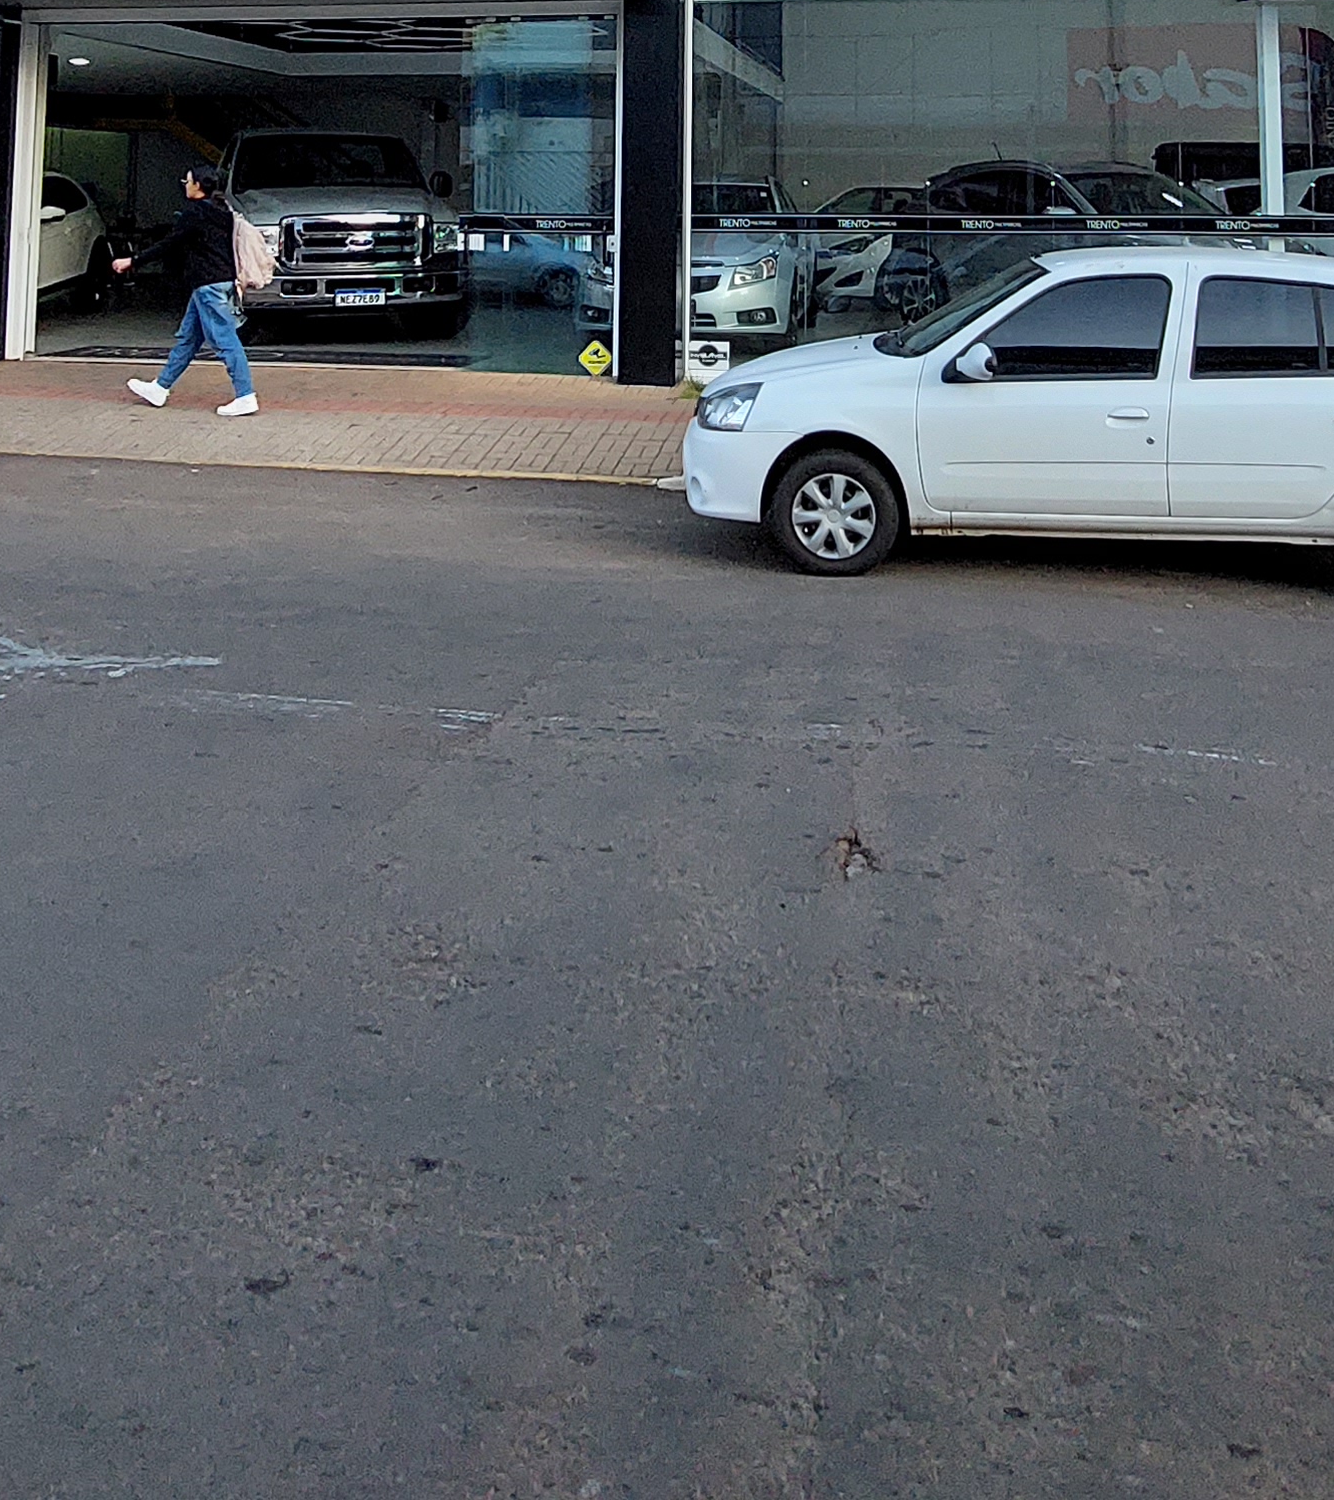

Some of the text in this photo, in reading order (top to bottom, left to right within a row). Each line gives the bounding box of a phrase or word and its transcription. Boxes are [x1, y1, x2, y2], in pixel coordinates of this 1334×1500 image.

[536, 220, 566, 229] TRENTO
[719, 219, 751, 228] TRENTO
[837, 219, 870, 229] TRENTO
[961, 219, 994, 229] TRENTO
[1086, 219, 1120, 229] TRENTO
[1215, 220, 1251, 230] TRENTO
